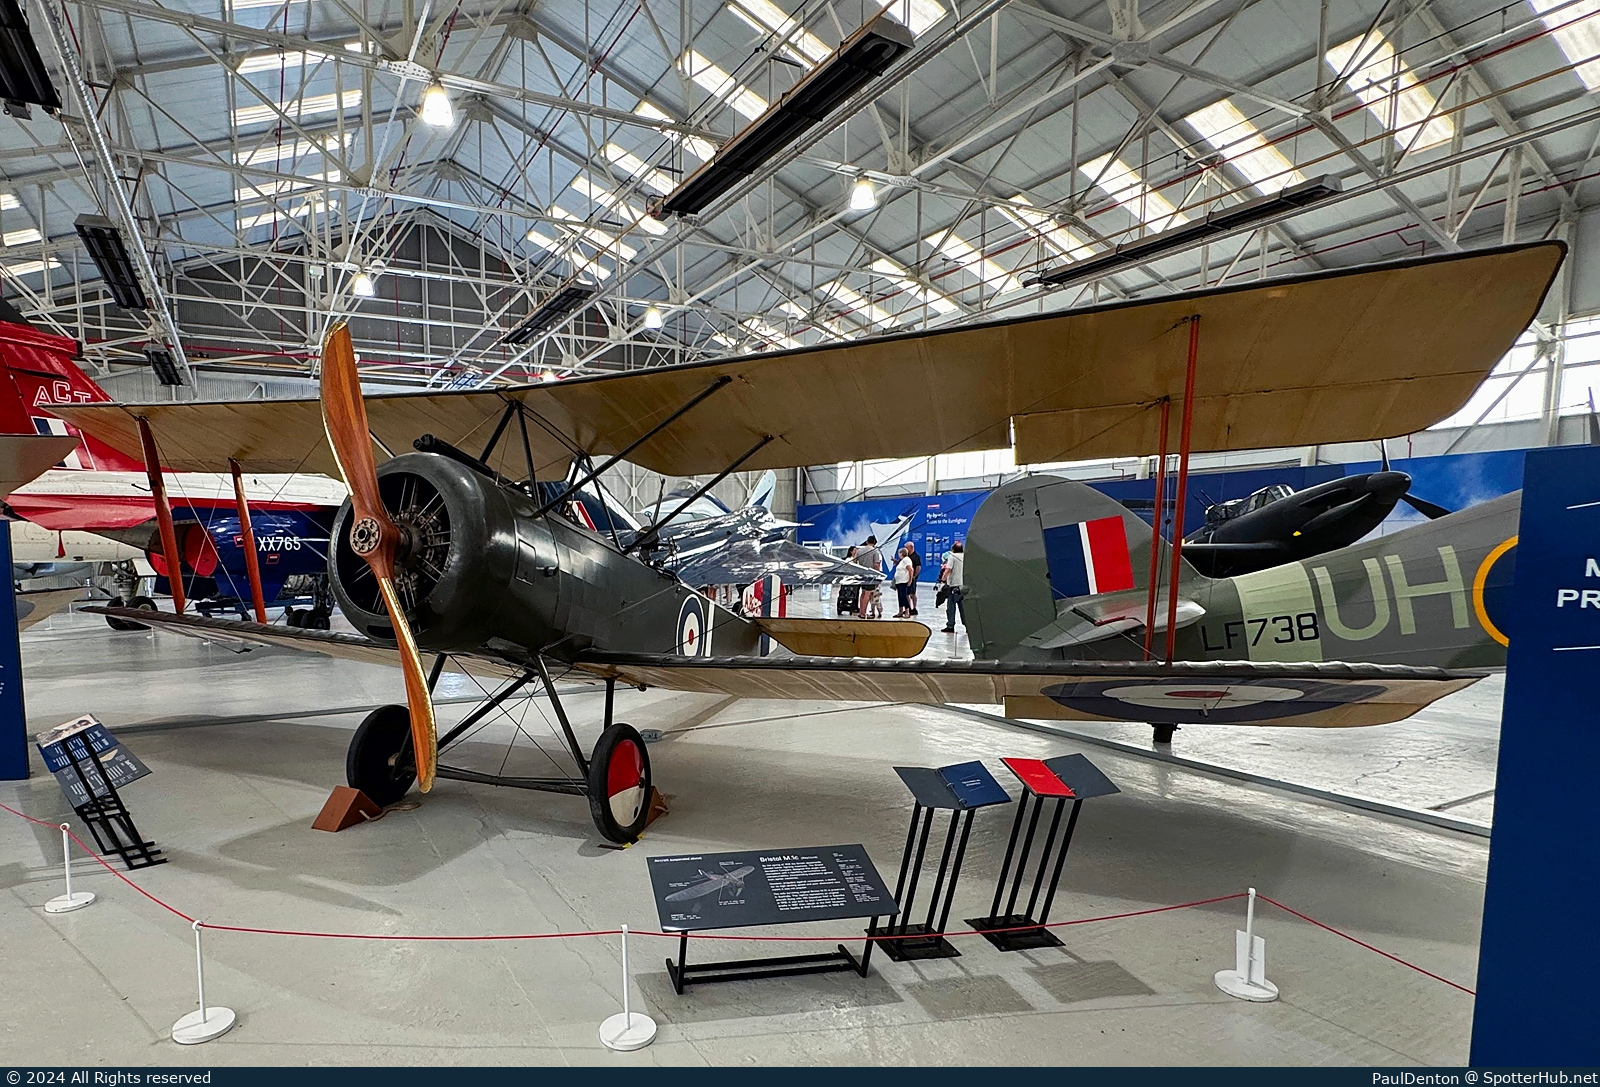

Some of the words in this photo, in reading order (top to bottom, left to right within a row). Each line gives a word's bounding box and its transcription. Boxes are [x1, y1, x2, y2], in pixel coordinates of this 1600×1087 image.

[32, 380, 91, 406] ACT
[257, 536, 301, 552] XX765
[1312, 545, 1469, 641] UH
[1556, 588, 1600, 609] PR
[1200, 612, 1320, 652] LF738
[759, 855, 782, 863] Bristol
